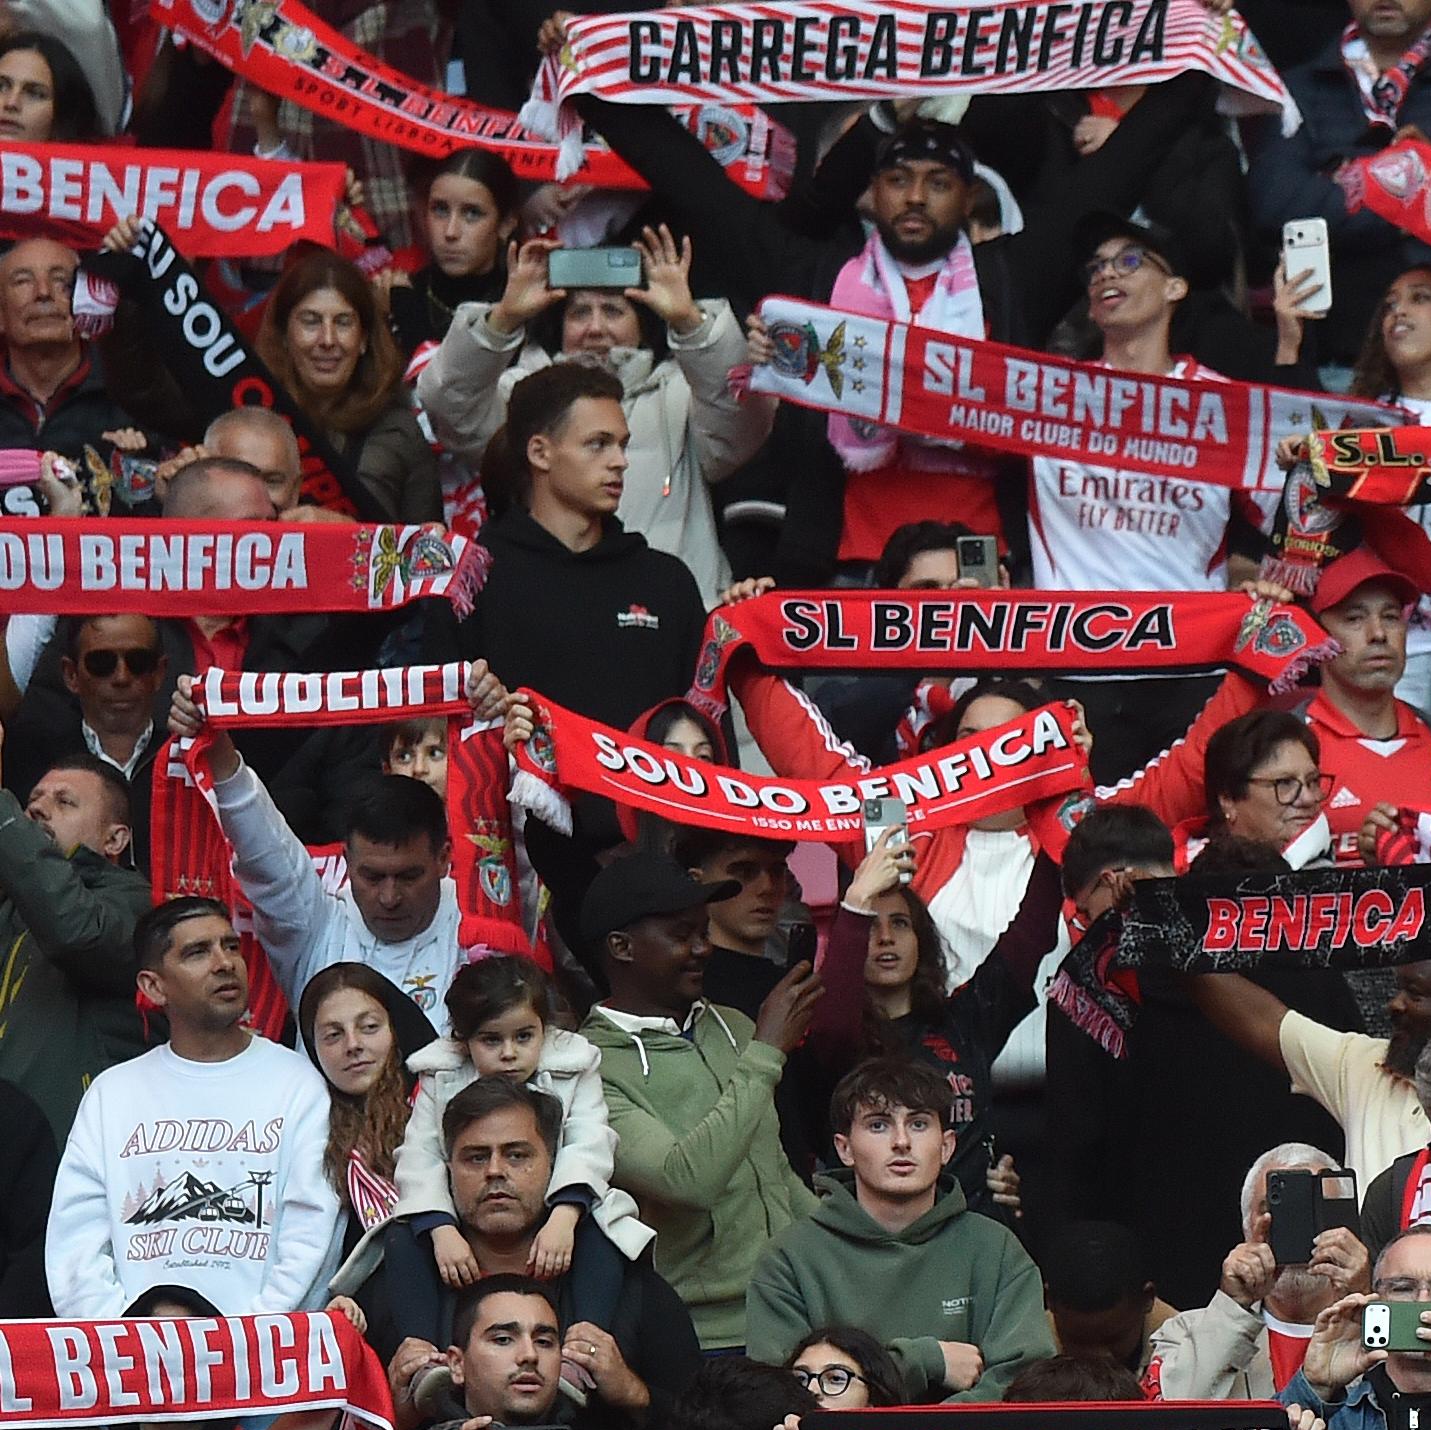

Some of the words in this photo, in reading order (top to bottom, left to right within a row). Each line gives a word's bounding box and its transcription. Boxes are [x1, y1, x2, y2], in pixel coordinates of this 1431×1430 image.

[628, 14, 898, 84] CARREGA
[919, 0, 1163, 81] BENFICA
[1, 152, 306, 233] BENFICA
[163, 272, 247, 378] SOU
[922, 338, 985, 402] SL
[1001, 357, 1230, 443] BENFICA
[950, 403, 1014, 445] MAIOR
[1021, 420, 1083, 454] CLUBE
[1089, 430, 1116, 458] DO
[1122, 435, 1198, 468] MUNDO
[1331, 432, 1427, 467] S.L.
[1055, 469, 1204, 512] Emirates
[1078, 502, 1116, 530] FLY
[1119, 506, 1181, 540] BETTER
[80, 532, 308, 592] BENFICA
[782, 600, 851, 649] SL
[871, 601, 1177, 653] BENFICA
[591, 732, 706, 796] SOU
[717, 775, 807, 815] DO
[1203, 887, 1426, 952] BENFICA
[120, 1117, 284, 1158] ADIDAS
[127, 1228, 177, 1261] SKI
[181, 1226, 271, 1261] CLUB
[46, 1311, 347, 1411] BENFICA
